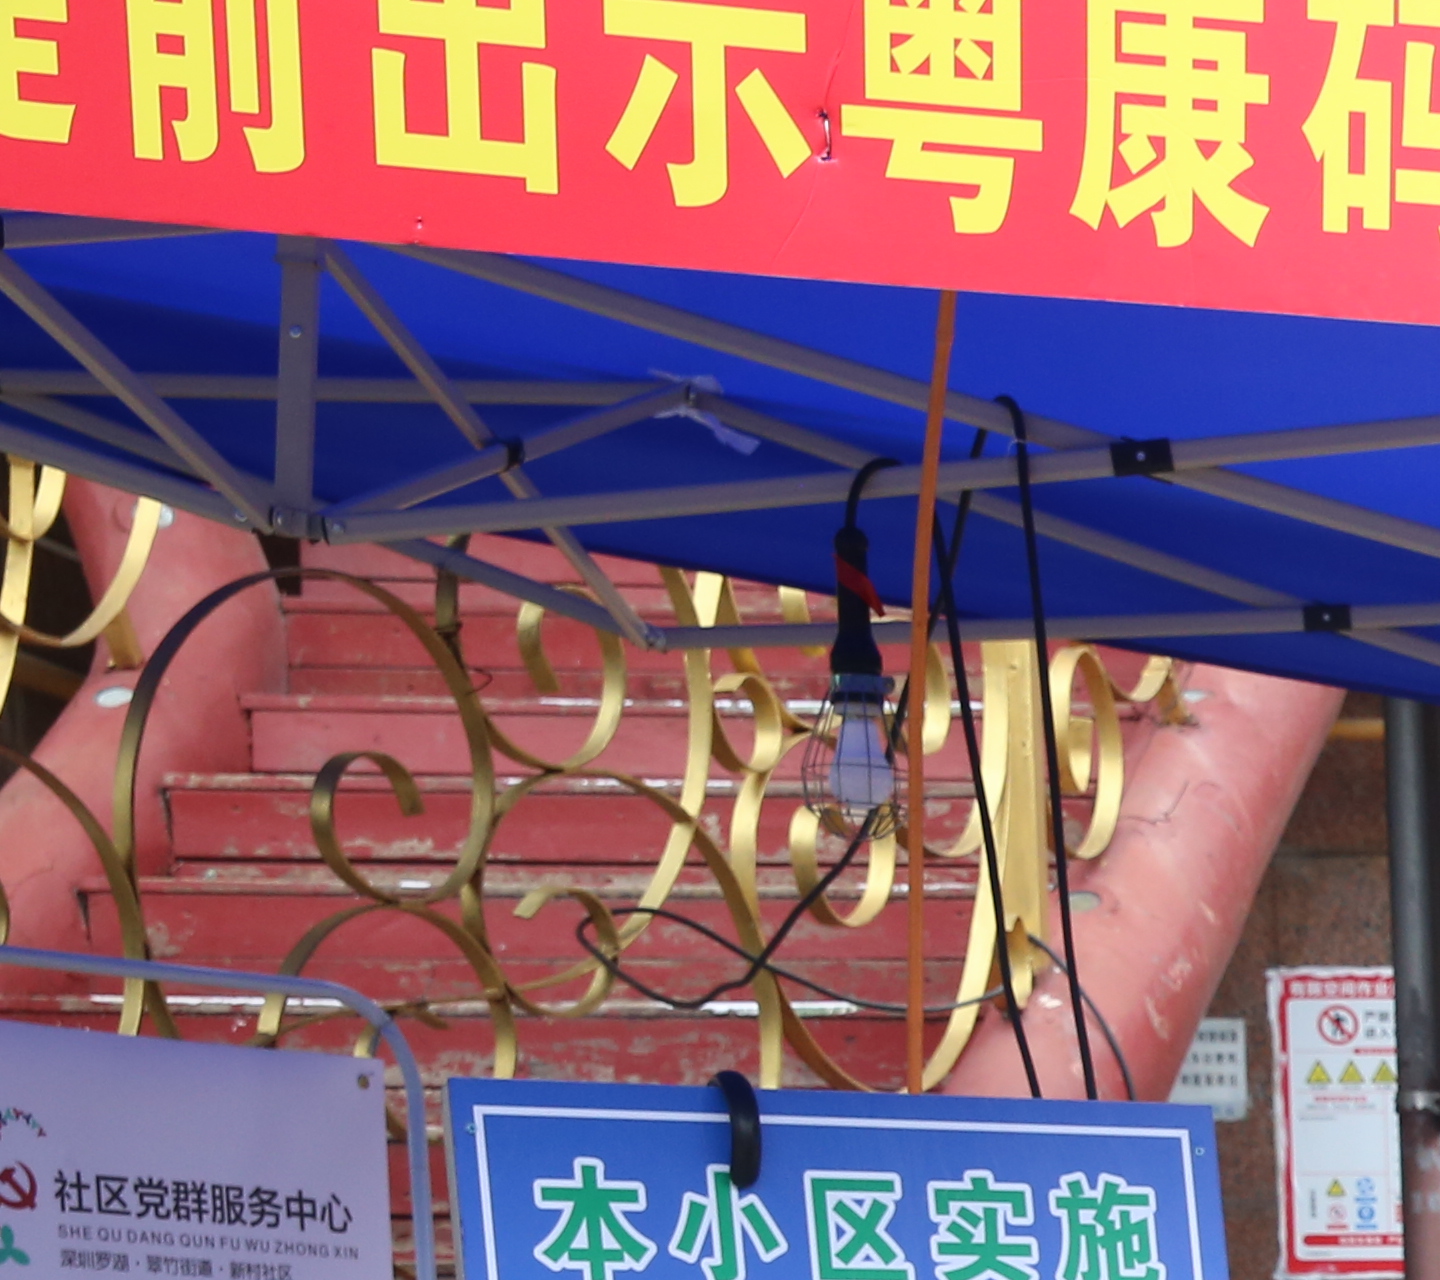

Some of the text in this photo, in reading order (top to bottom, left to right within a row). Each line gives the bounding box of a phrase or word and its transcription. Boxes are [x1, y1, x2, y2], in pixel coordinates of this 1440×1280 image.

[54, 1169, 353, 1234] 社区党群服务中心
[58, 1224, 360, 1261] SHE QU DANG QUN FU WU ZHONG XIN
